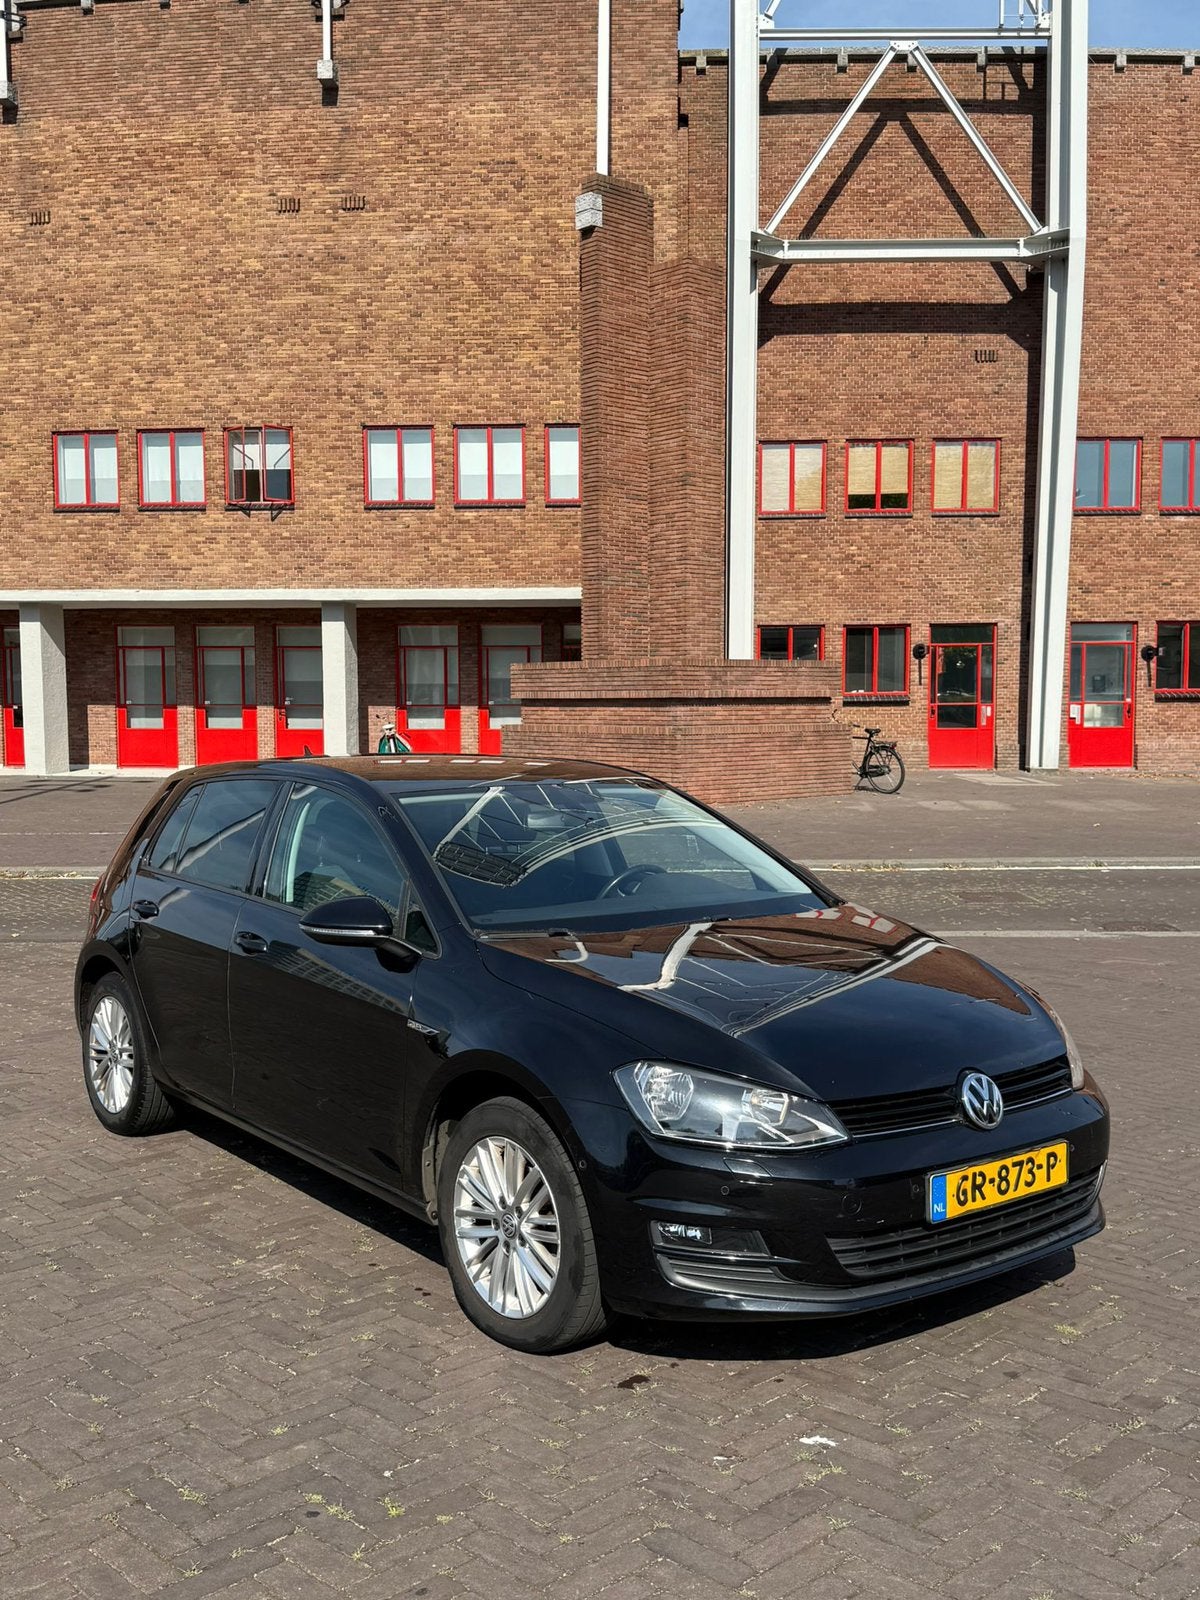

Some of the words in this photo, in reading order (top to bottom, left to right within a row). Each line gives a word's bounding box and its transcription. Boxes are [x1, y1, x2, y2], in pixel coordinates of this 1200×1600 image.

[963, 1073, 1002, 1129] VW
[955, 1151, 1058, 1207] GR-873-P
[933, 1202, 946, 1213] NL
